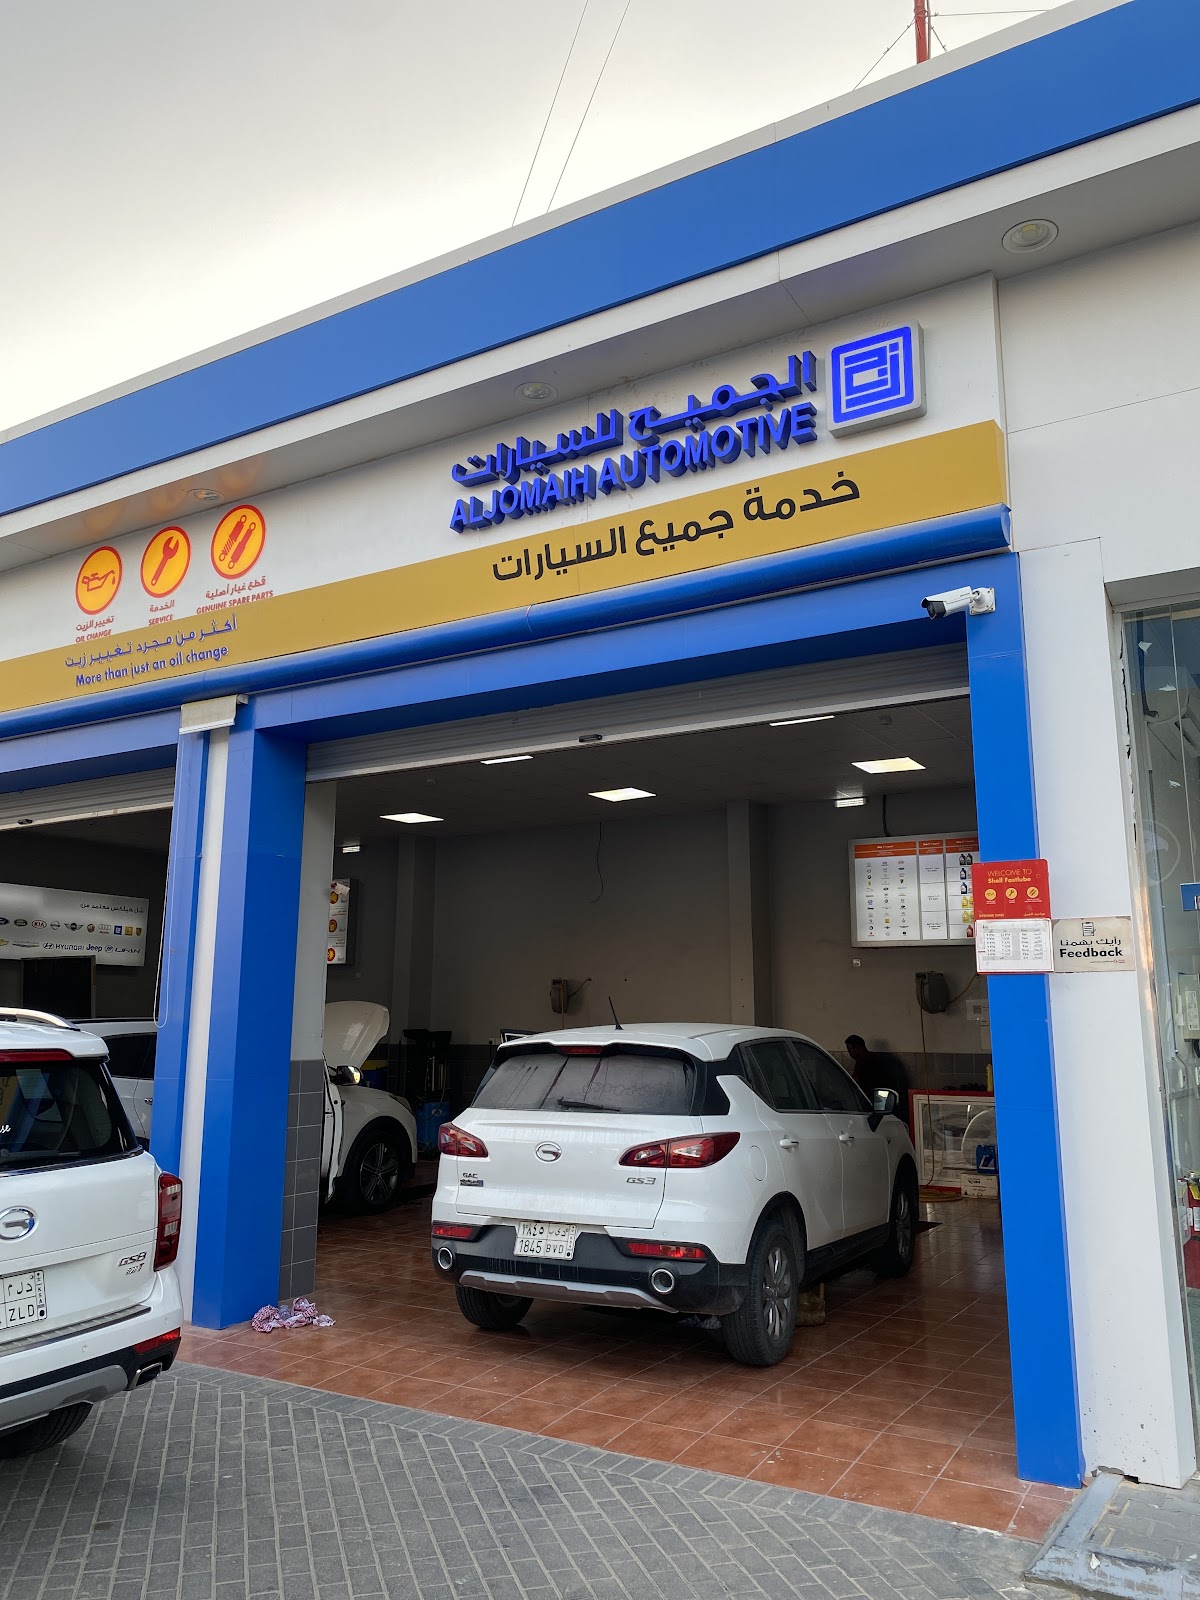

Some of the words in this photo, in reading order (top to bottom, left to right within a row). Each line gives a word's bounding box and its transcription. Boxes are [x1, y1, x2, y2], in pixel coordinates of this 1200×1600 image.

[628, 351, 817, 447] الجميح
[452, 409, 623, 487] للسيارات
[450, 464, 597, 533] ALJOMAIH
[598, 402, 817, 495] AUTOMOTIVE
[743, 471, 860, 521] خدمة
[635, 509, 734, 556] جميع
[492, 525, 627, 581] السيارات
[230, 582, 247, 596] غيار
[247, 575, 266, 591] قطع
[205, 586, 230, 599] أصلية
[149, 600, 175, 613] الخدمة
[196, 601, 228, 615] GENUINE
[228, 596, 250, 608] SPARE
[251, 589, 274, 603] PARTS
[75, 620, 94, 632] الزيت
[94, 615, 115, 629] تغيير
[148, 614, 174, 626] SERVICE
[199, 612, 238, 642] أكثر
[75, 634, 86, 643] OIL
[86, 629, 112, 641] CHANGE
[175, 629, 196, 646] من
[136, 636, 173, 654] مجرد
[65, 652, 87, 669] زيت
[89, 642, 133, 666] تغيير
[75, 673, 102, 687] More
[104, 665, 129, 680] than
[130, 661, 150, 679] just
[152, 660, 167, 670] an
[169, 651, 184, 667] oil
[186, 646, 229, 663] change
[987, 869, 1021, 877] WELCOME
[86, 943, 103, 953] Jeep
[1060, 939, 1093, 947] يهمنا
[1095, 936, 1122, 947] رأيك
[1059, 947, 1123, 958] Feedback
[626, 1176, 657, 1186] GS3
[519, 1239, 542, 1254] 1845
